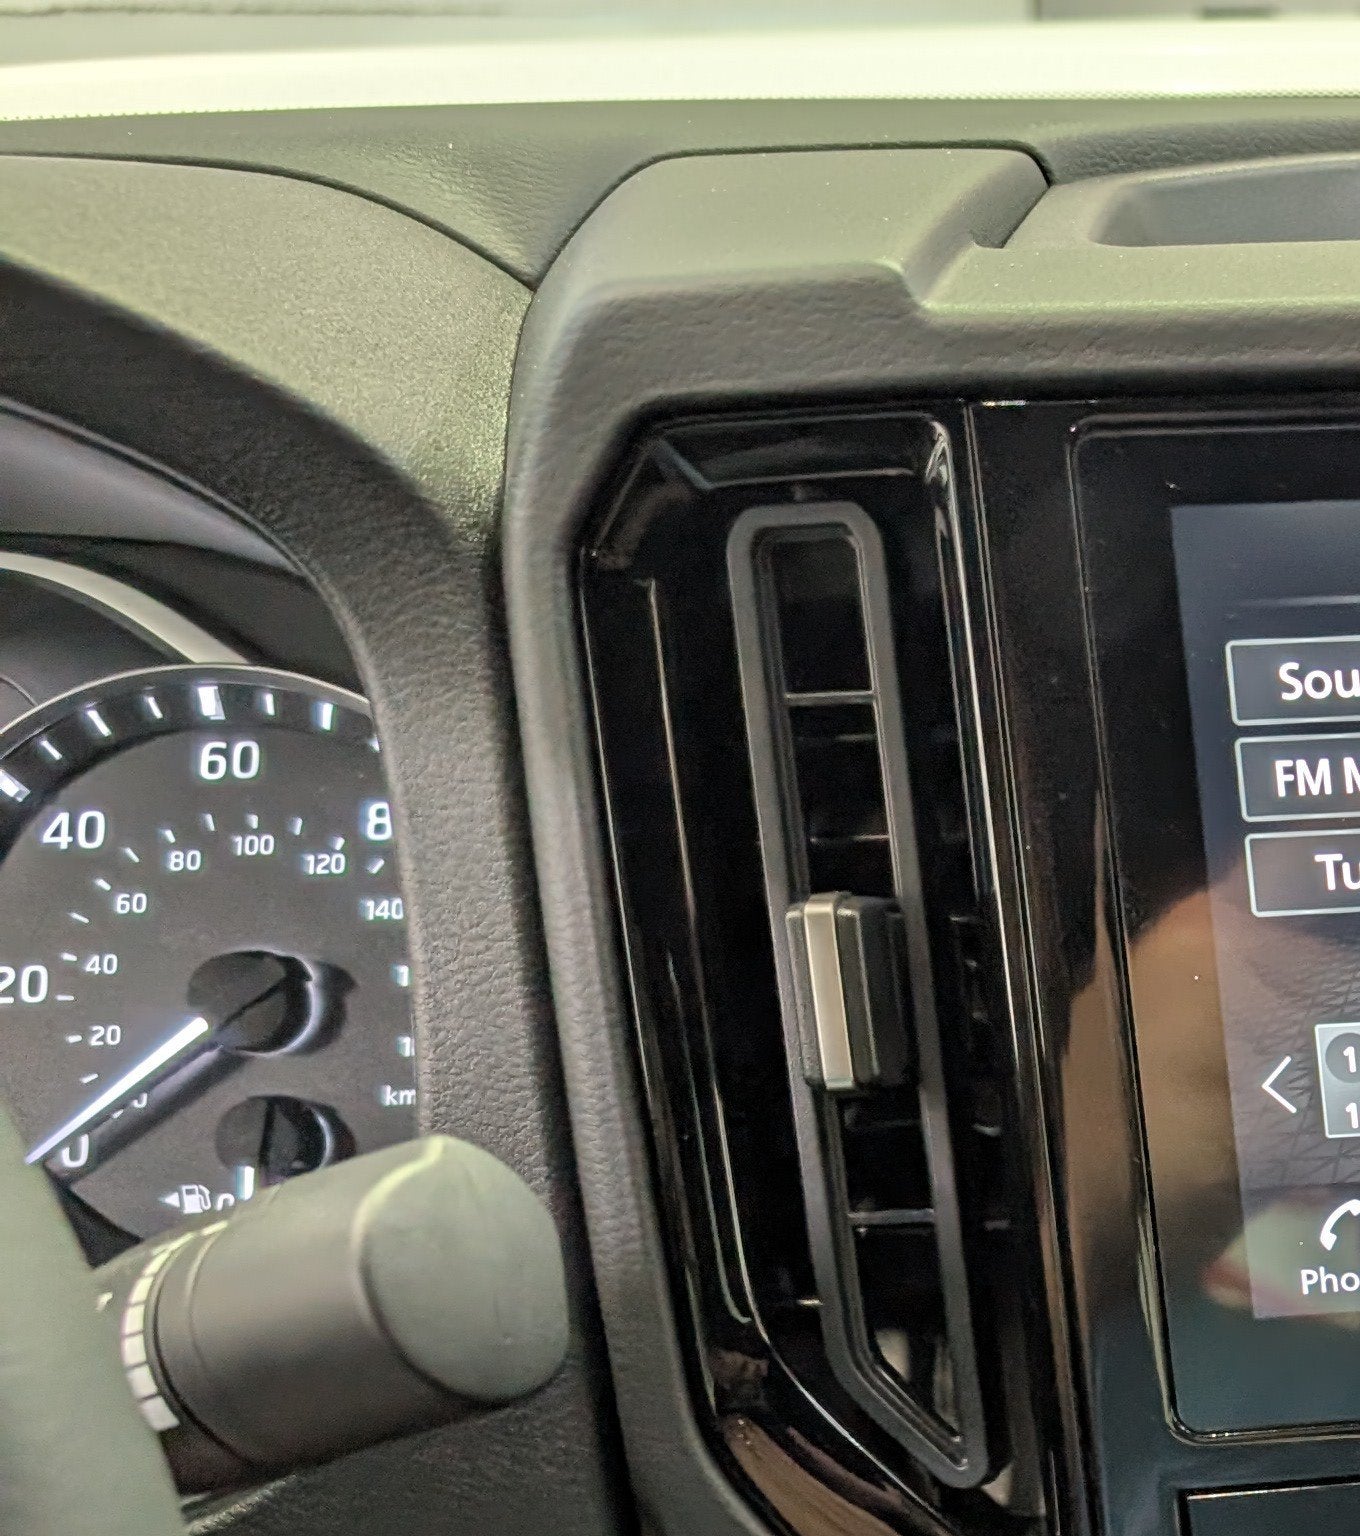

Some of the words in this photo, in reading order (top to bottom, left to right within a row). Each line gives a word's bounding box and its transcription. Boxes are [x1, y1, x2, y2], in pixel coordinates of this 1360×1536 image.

[199, 739, 260, 781] 60
[1274, 759, 1332, 798] FM
[42, 810, 105, 850] 40
[366, 800, 393, 842] 8
[233, 834, 274, 856] 100
[168, 850, 202, 872] 80
[305, 853, 346, 875] 120
[115, 892, 148, 914] 60
[85, 953, 118, 975] 40
[89, 1025, 121, 1046] 20
[1343, 1046, 1357, 1073] 1
